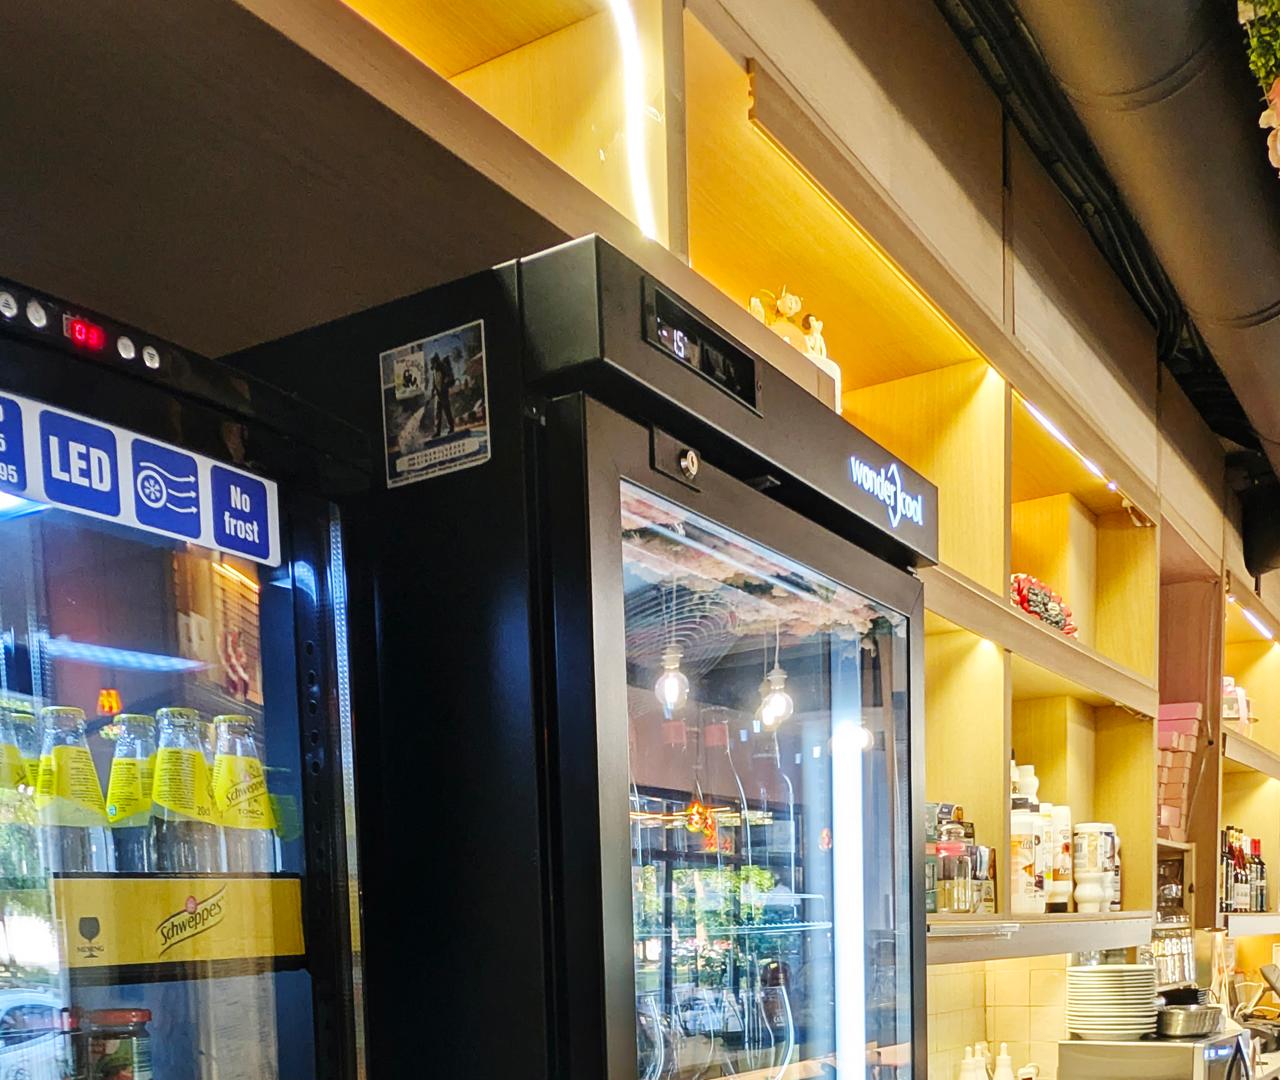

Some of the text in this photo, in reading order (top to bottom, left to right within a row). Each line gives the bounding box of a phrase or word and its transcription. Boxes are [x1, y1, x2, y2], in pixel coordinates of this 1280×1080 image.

[48, 434, 113, 493] LED
[229, 484, 251, 513] No
[223, 511, 260, 545] frost
[159, 898, 223, 946] Schweppes
